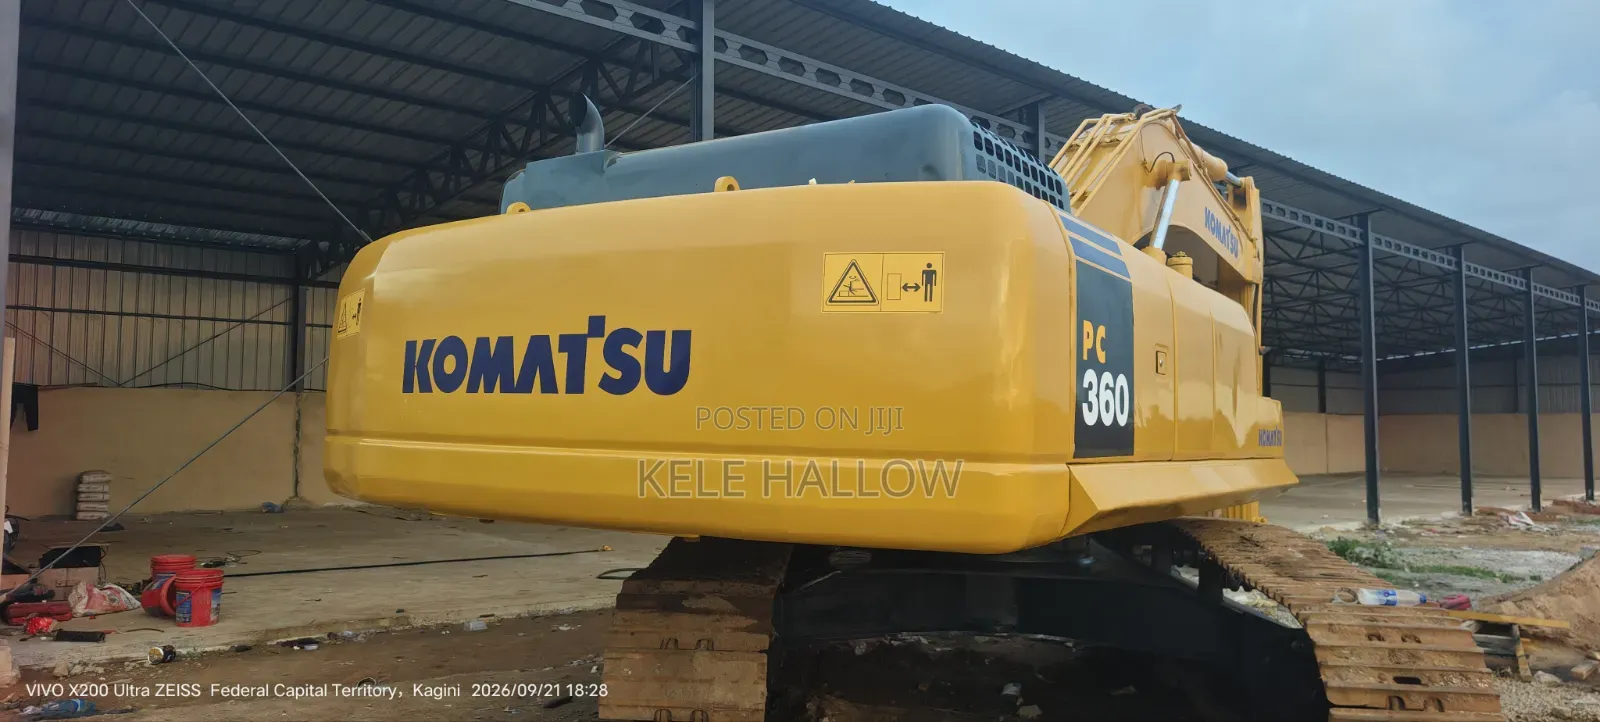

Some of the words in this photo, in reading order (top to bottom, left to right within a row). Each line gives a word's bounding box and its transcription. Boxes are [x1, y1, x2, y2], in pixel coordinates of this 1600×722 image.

[1204, 206, 1239, 258] KOMATSU
[402, 315, 692, 395] KOMATSU
[1082, 320, 1106, 364] PC
[1082, 368, 1130, 427] 360
